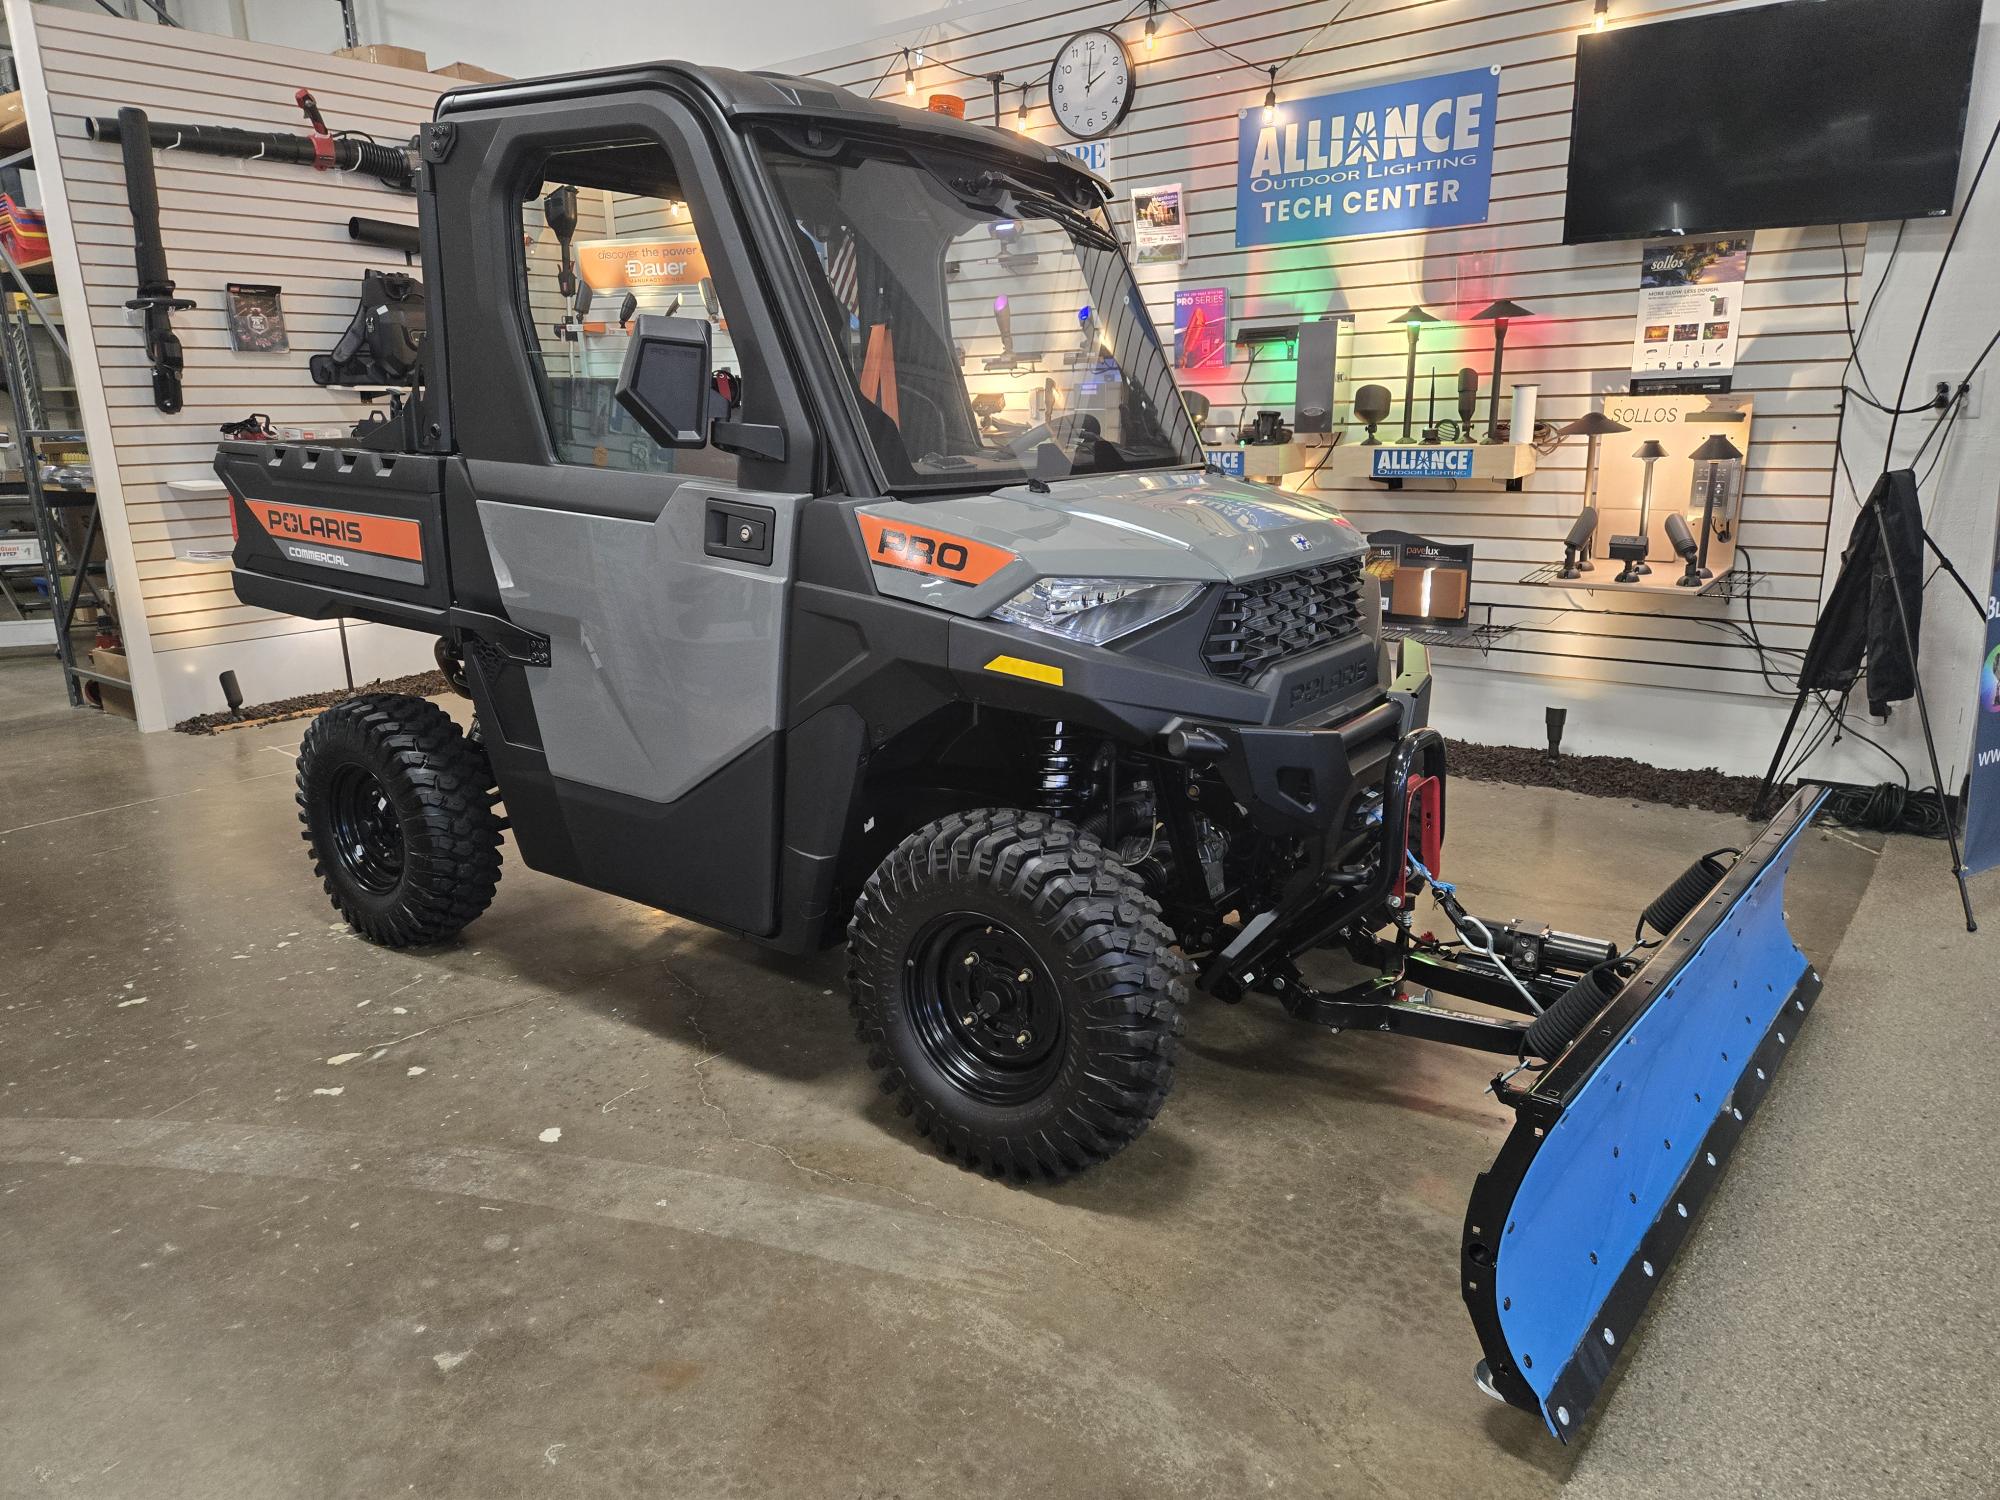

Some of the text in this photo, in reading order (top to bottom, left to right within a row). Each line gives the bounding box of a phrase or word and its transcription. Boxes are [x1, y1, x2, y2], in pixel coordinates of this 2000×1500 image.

[1085, 41, 1095, 50] 12
[1103, 44, 1107, 53] 1
[1072, 48, 1079, 58] 11
[1112, 56, 1119, 66] 2
[1061, 64, 1072, 75] 10
[1116, 75, 1124, 85] 3
[1057, 84, 1064, 93] 9
[1111, 96, 1119, 105] 4
[1062, 102, 1069, 112] 8
[1074, 115, 1080, 124] 7
[1101, 111, 1108, 120] 5
[1086, 118, 1094, 127] 6
[1250, 92, 1483, 179] ALLIANCE
[1250, 154, 1477, 193] OUTDOOR LIGHTING
[1261, 179, 1460, 223] TECH CENTER
[597, 247, 697, 260] discover the power
[1650, 254, 1685, 271] sollos
[1176, 295, 1224, 306] PRO SERIES
[1611, 407, 1678, 423] SOLLOS
[1377, 450, 1469, 470] ALLIANCE
[267, 509, 362, 543] POLARIS
[877, 528, 968, 571] PRO
[1406, 545, 1439, 556] pavelux
[288, 546, 349, 567] COMMERCIAL
[1289, 660, 1369, 708] POLARIS
[1416, 1004, 1497, 1024] POLARIS
